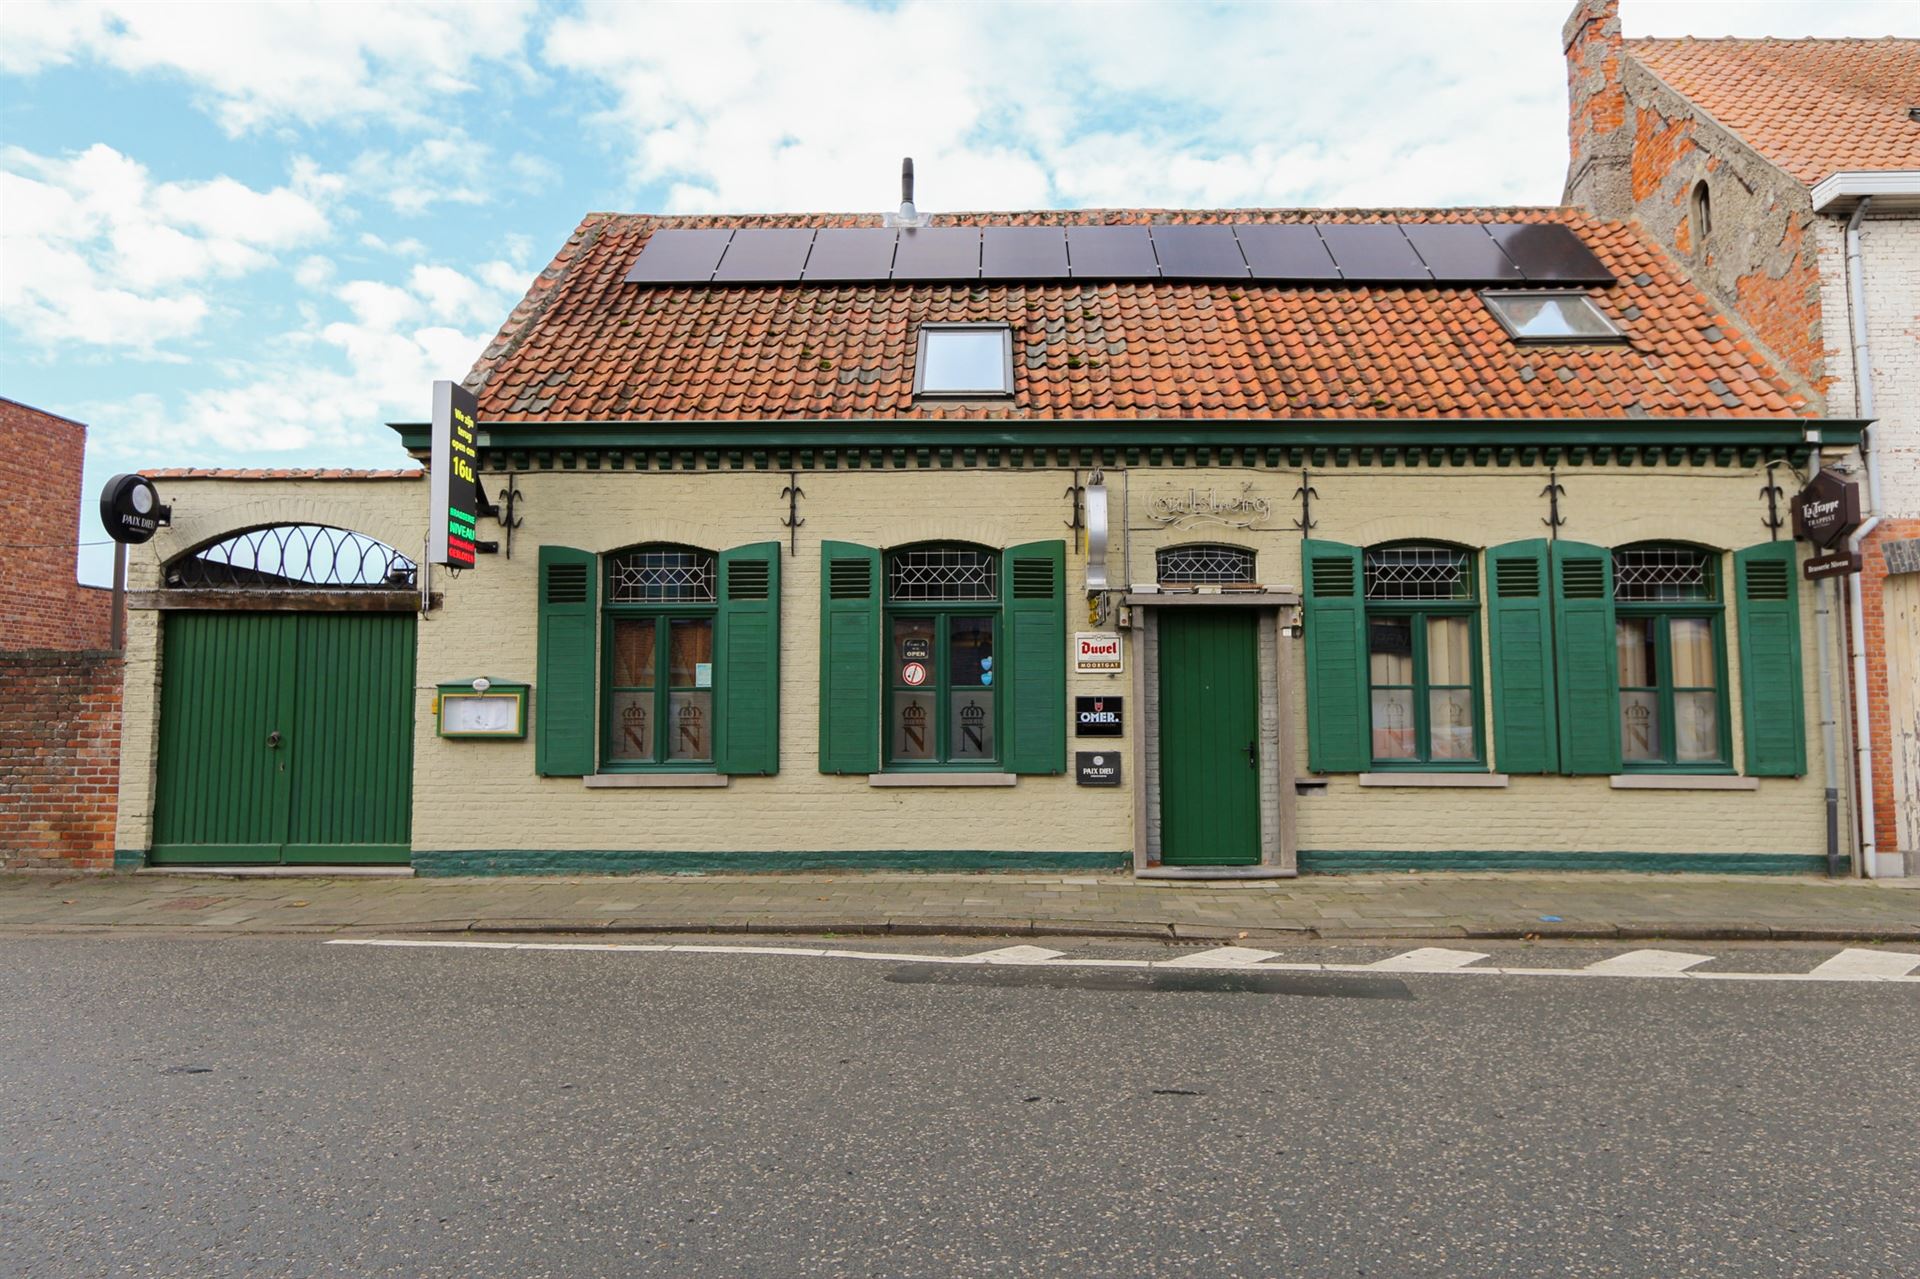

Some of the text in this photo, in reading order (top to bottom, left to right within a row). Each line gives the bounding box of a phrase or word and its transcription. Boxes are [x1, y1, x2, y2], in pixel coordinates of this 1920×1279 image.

[452, 439, 466, 451] open
[453, 456, 475, 483] 16u.
[1802, 500, 1839, 519] La Trappe
[122, 513, 141, 526] PAIX
[1808, 514, 1836, 527] TRAPPIST
[449, 521, 475, 541] NIVEAU
[1808, 560, 1849, 574] Brasserie Niveau
[1081, 641, 1117, 654] Duvel
[622, 726, 645, 753] N
[678, 726, 702, 753] N
[902, 726, 926, 753] N
[960, 726, 985, 753] N
[1626, 724, 1650, 753] N
[1083, 767, 1114, 775] PAIX DIEU
